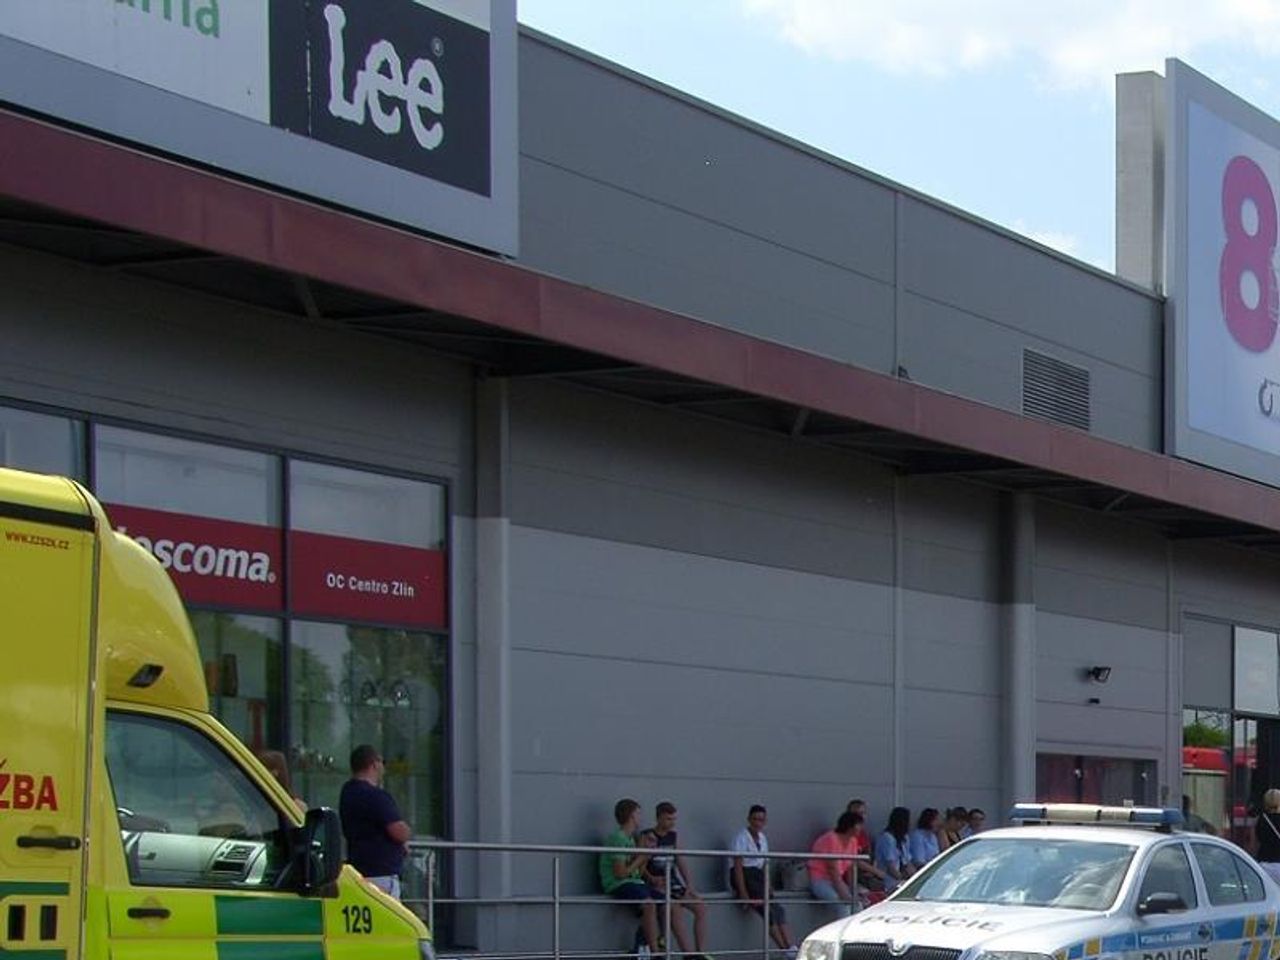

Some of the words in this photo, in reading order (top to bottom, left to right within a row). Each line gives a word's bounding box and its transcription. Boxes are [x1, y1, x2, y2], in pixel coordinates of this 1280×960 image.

[324, 3, 444, 150] Lee
[326, 572, 345, 589] OC
[349, 575, 389, 595] Centro
[342, 905, 372, 933] 129
[860, 914, 1004, 932] POLICIE
